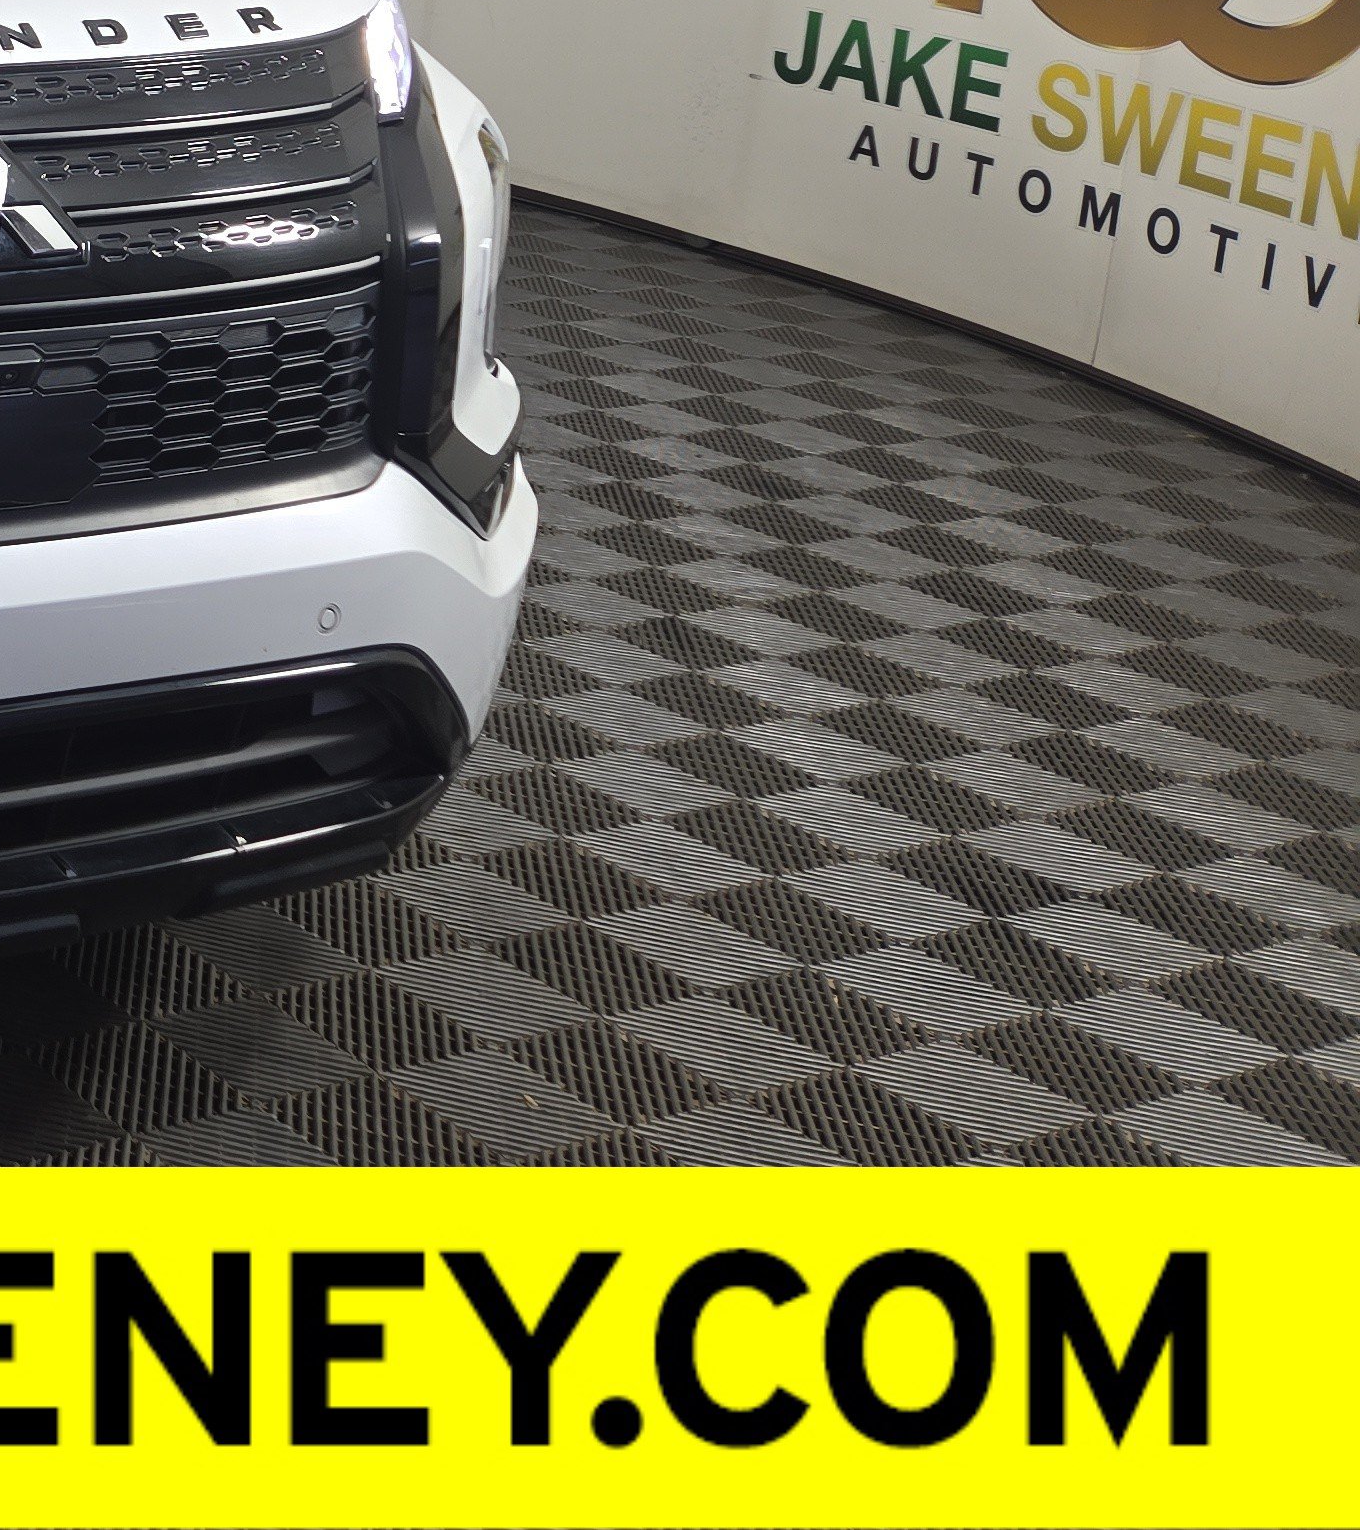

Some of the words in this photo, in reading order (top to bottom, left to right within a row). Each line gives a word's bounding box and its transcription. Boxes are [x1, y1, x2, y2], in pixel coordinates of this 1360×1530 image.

[773, 10, 1009, 133] JAKE
[1031, 63, 1360, 242] SWEEN
[848, 124, 1360, 325] AUTOMOTIV
